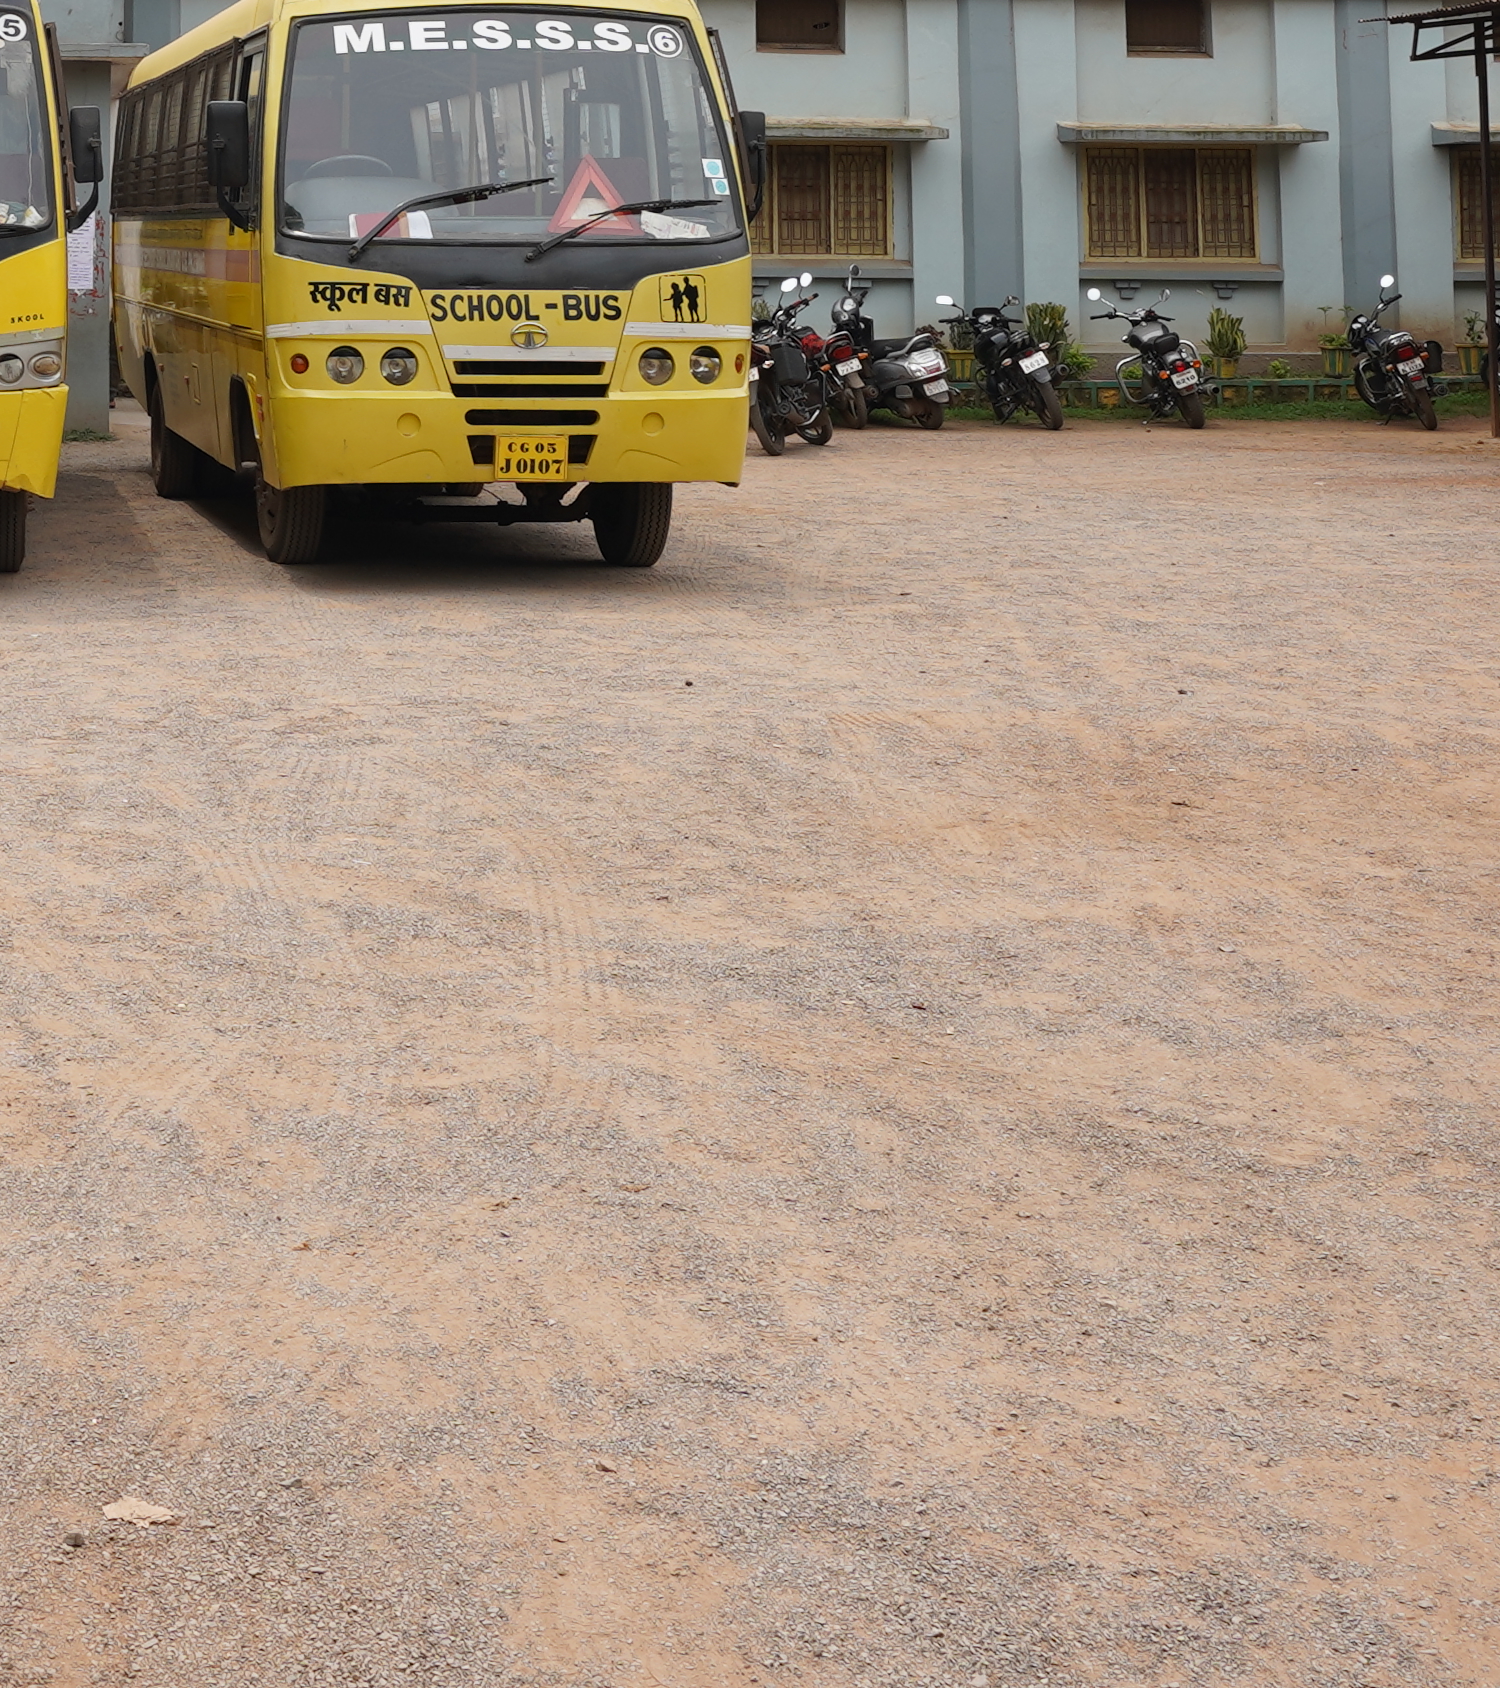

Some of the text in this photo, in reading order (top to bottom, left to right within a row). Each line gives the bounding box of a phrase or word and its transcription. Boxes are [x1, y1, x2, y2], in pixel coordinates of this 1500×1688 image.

[308, 282, 413, 311] स्कूल बस
[10, 314, 45, 324] SKOOL
